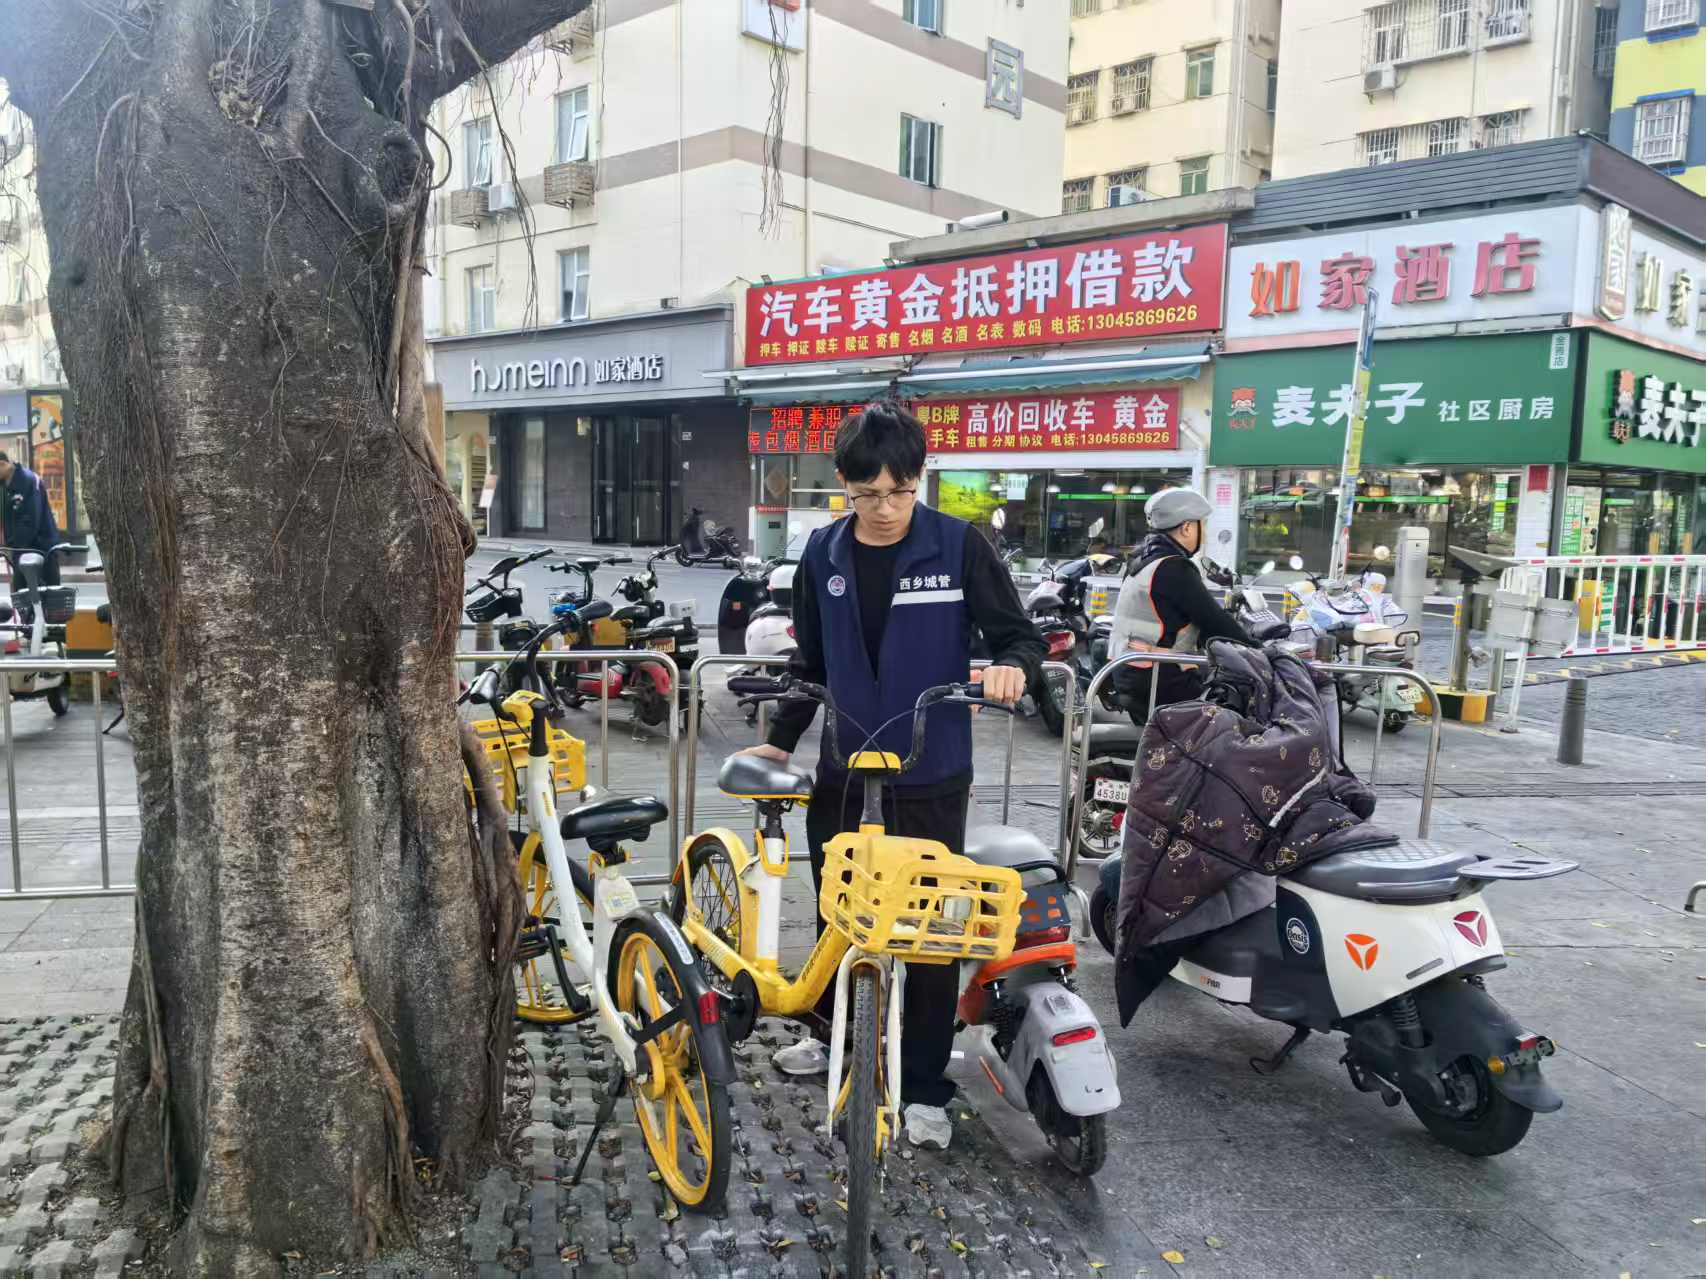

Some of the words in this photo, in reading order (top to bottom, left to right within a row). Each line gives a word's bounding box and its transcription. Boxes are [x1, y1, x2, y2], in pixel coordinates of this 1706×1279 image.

[759, 239, 1193, 337] 汽车黄金抵押借款
[1249, 232, 1540, 318] 如家酒店
[1634, 250, 1706, 336] 如家
[942, 325, 967, 344] 名酒
[976, 321, 1005, 341] 名表
[1013, 318, 1042, 338] 数码
[1052, 305, 1198, 335] 电话:13045869626
[594, 354, 663, 384] 如家酒店
[917, 404, 960, 425] 粤B牌
[967, 400, 1095, 435] 高价回收车
[1113, 394, 1169, 430] 黄金
[1272, 382, 1426, 428] 麦夫子
[1438, 397, 1555, 423] 社区厨房
[926, 428, 960, 448] 手车
[1051, 431, 1170, 447] 电话:13045869626
[900, 575, 951, 591] 西乡城管
